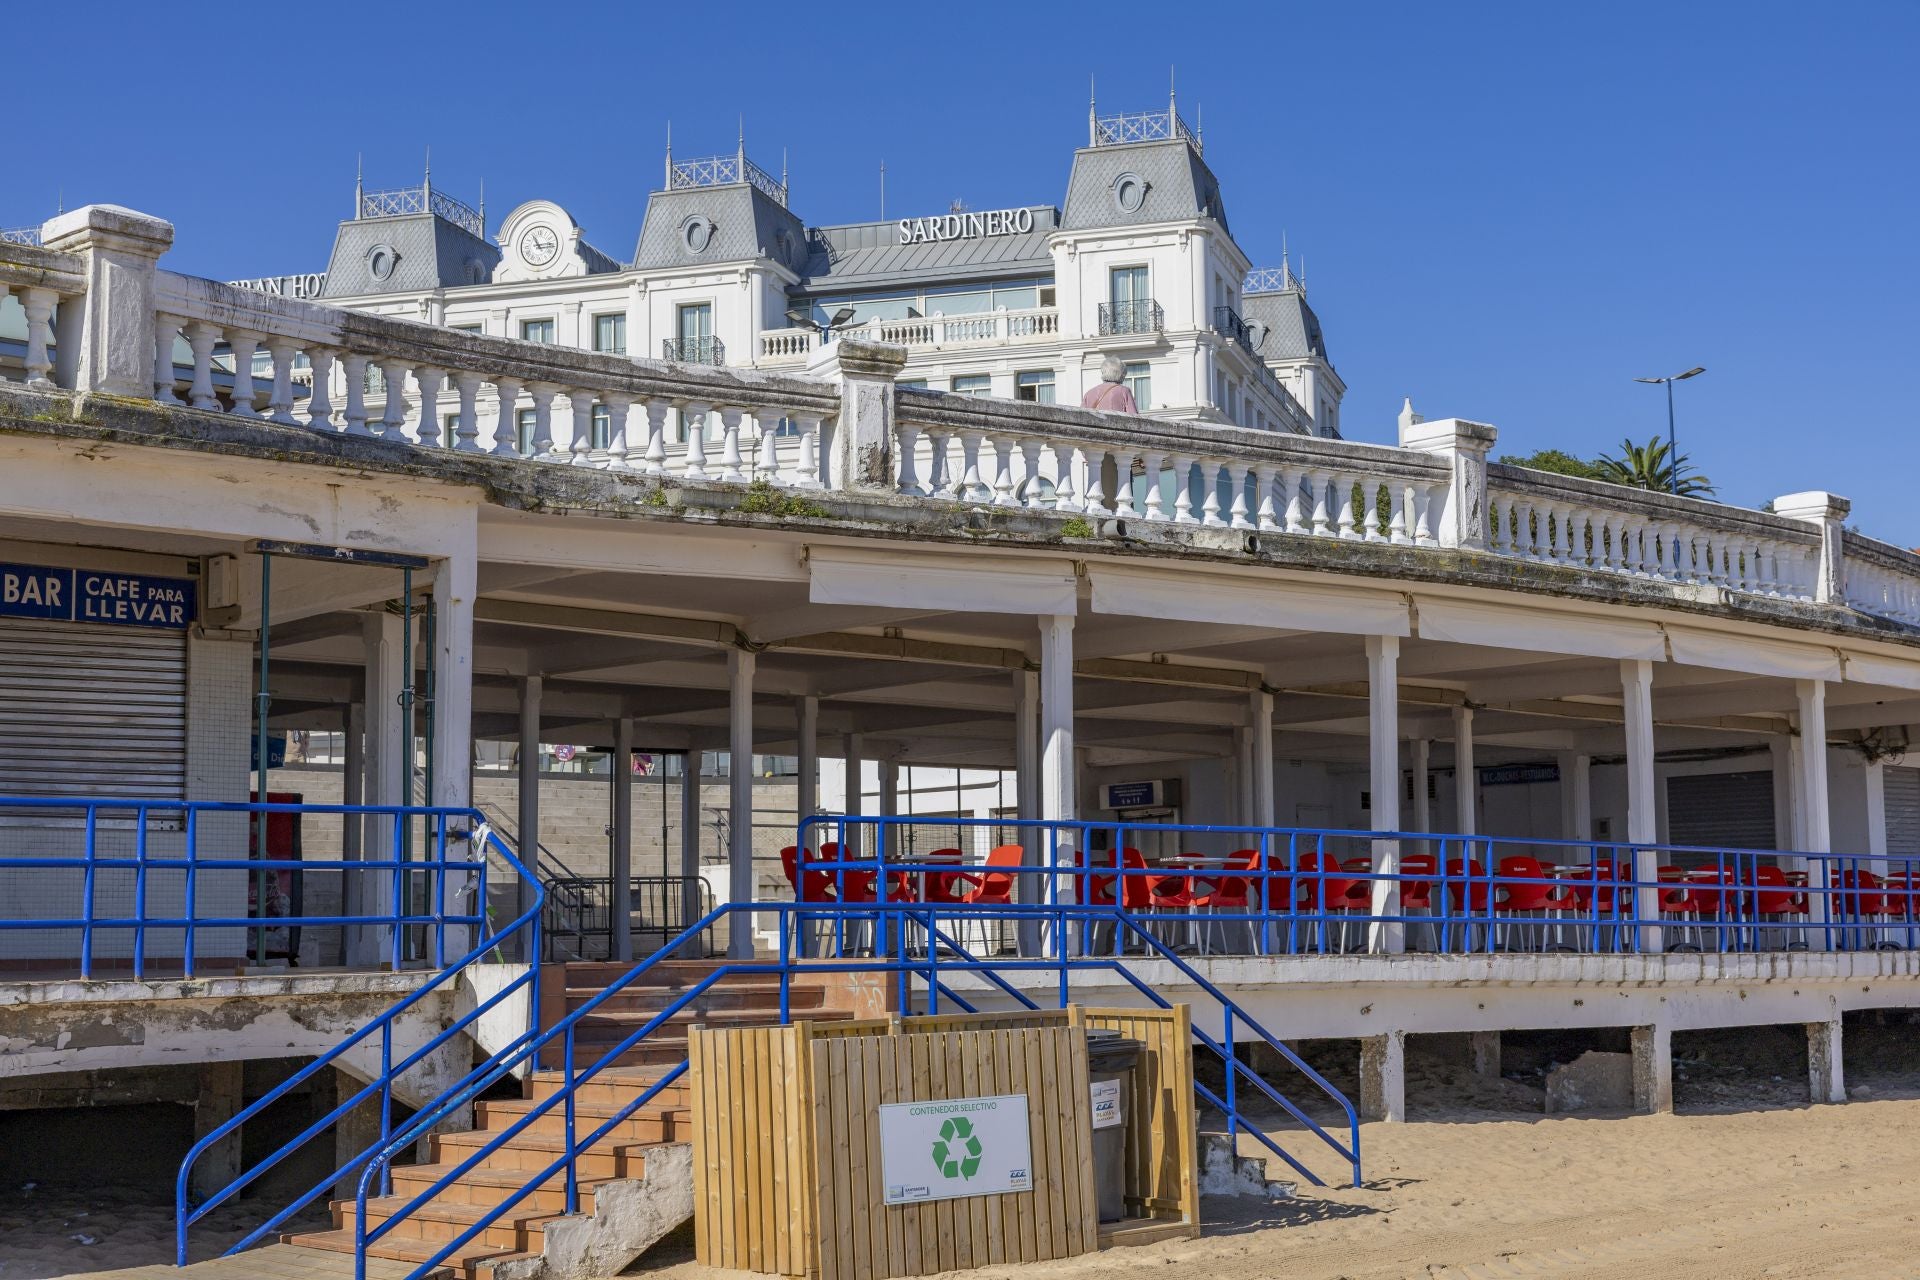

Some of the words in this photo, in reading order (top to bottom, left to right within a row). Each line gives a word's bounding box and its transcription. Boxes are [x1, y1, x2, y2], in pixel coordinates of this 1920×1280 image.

[899, 207, 1033, 245] SARDINERO
[4, 573, 62, 607] BAR
[85, 577, 140, 599] CAFE
[148, 587, 184, 603] PARA
[85, 598, 184, 624] LLEVAR
[909, 1104, 959, 1116] CONTENEDOR
[960, 1101, 997, 1112] SELECTIVO
